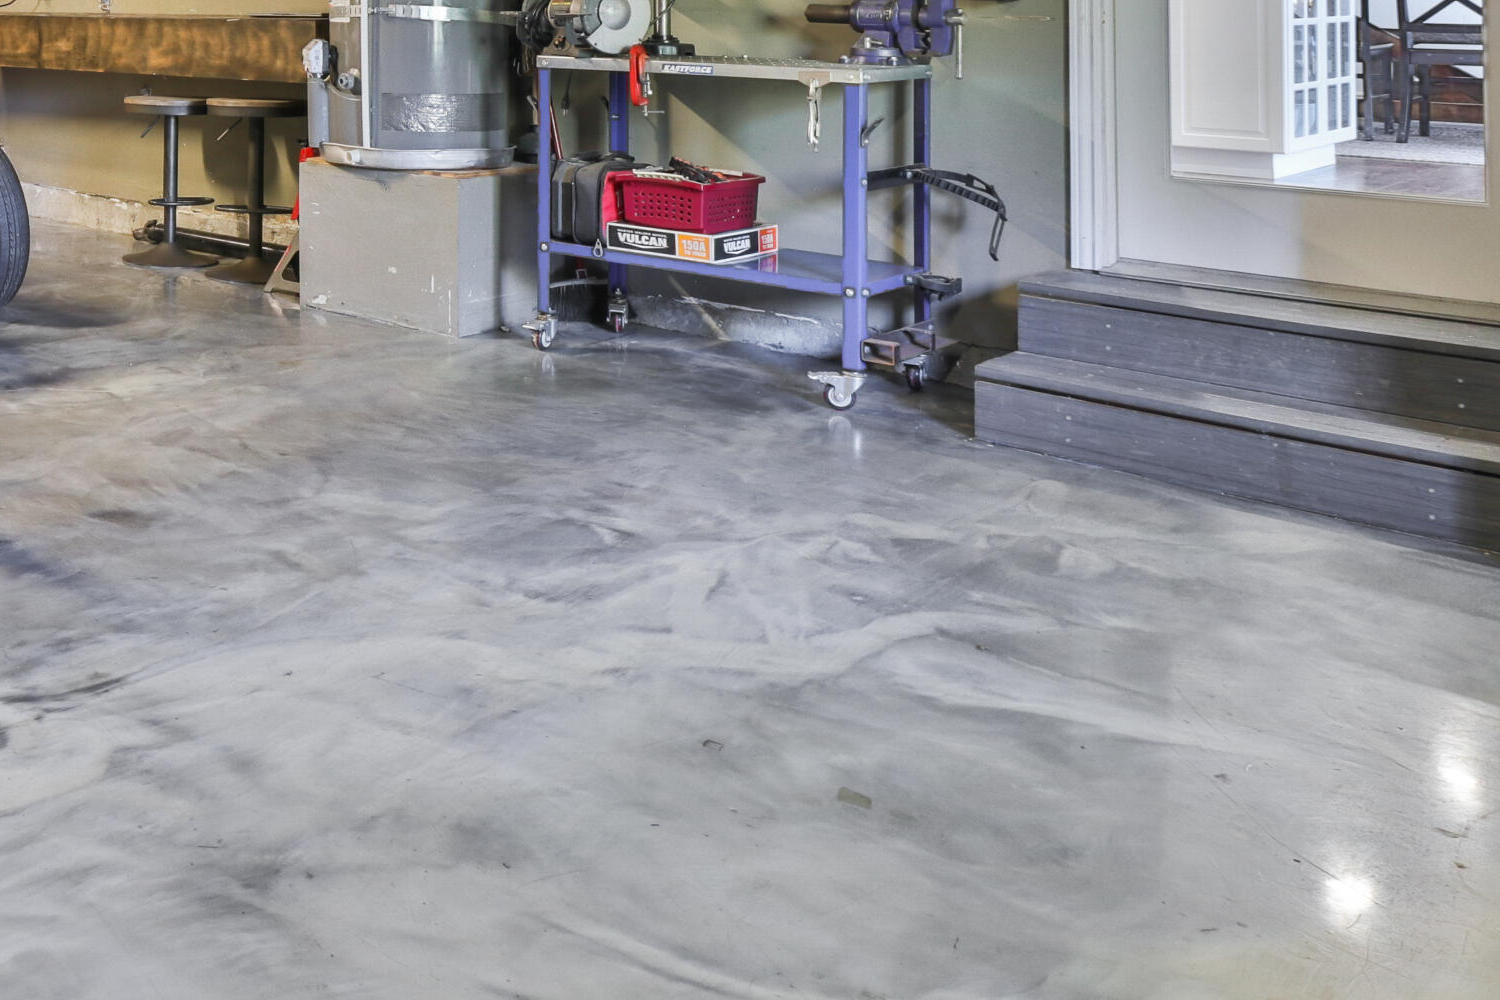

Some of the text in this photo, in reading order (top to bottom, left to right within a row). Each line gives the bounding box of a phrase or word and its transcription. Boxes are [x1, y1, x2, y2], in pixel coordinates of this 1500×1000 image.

[617, 232, 667, 247] VULCAN
[682, 239, 706, 251] 150A
[723, 238, 751, 252] VULCAN
